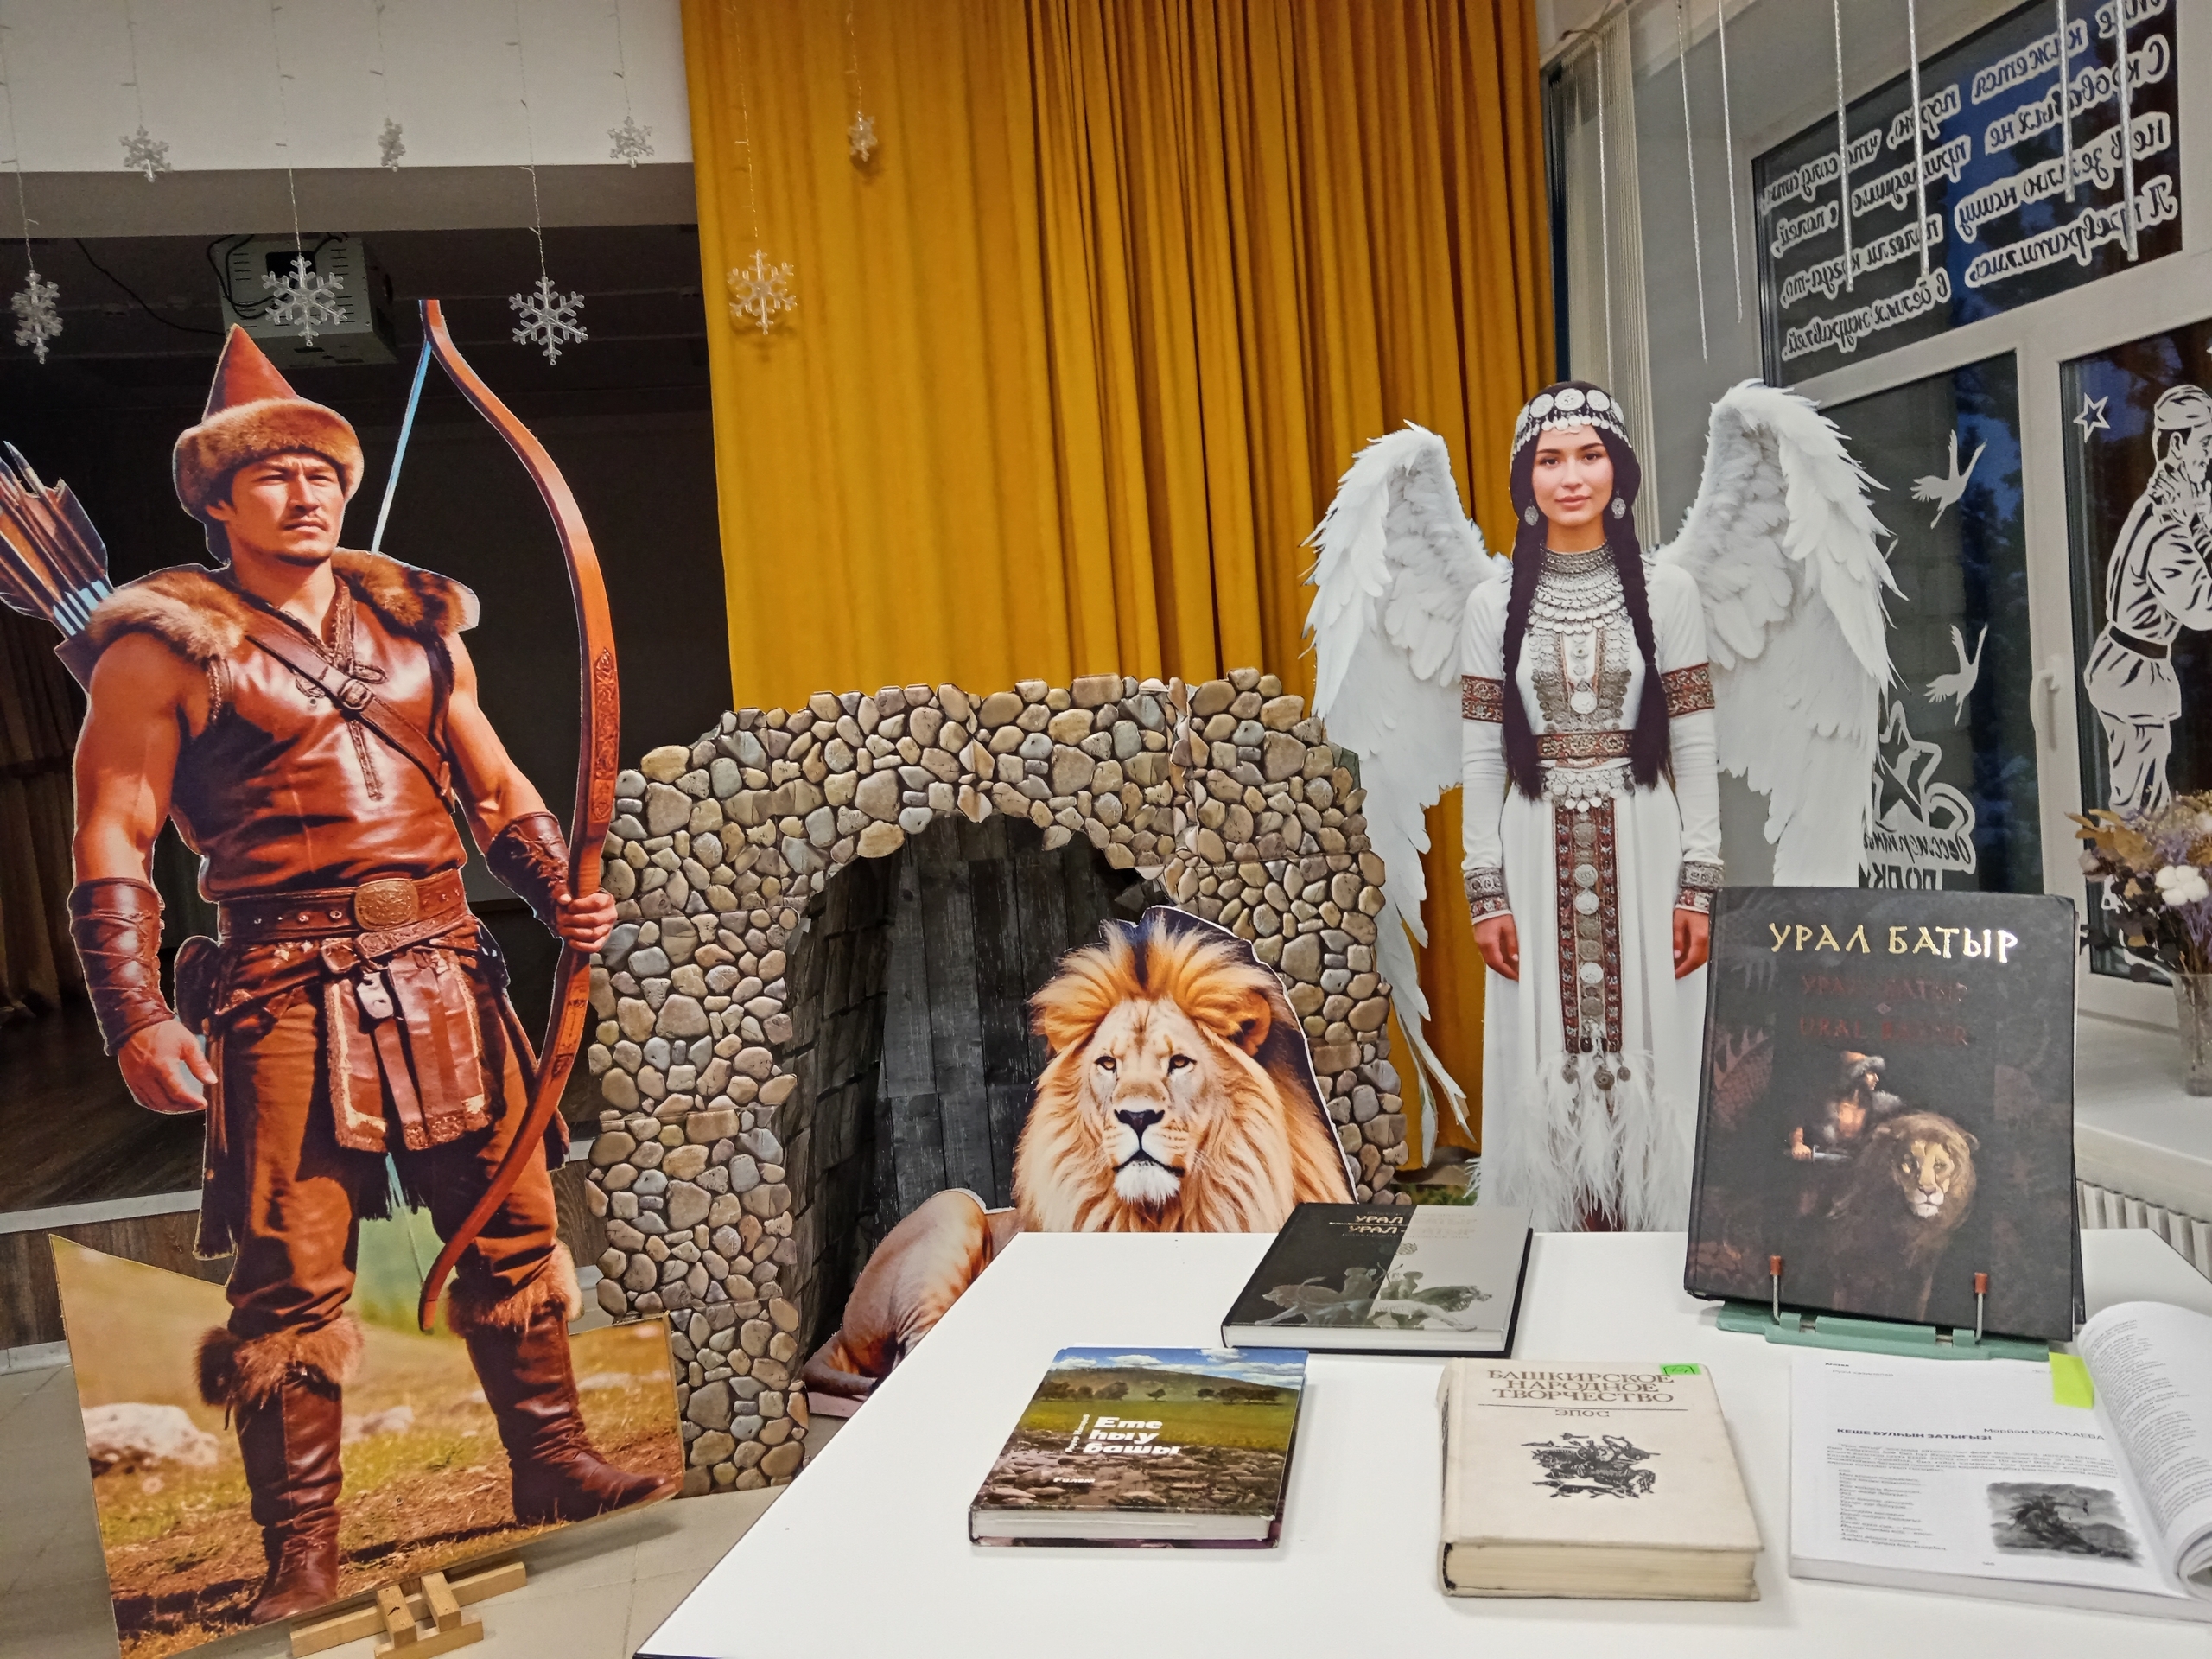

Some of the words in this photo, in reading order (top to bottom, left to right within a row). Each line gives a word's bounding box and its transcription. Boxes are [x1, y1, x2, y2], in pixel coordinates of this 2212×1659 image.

[1769, 922, 1871, 954] УРАЛ
[1888, 925, 2018, 963] БАТЫР
[1355, 1215, 1404, 1224] УРАЛ
[1487, 1370, 1675, 1383] БАШКИРСКОЕ
[1506, 1380, 1659, 1393] НАРОДНОЕ
[1492, 1389, 1675, 1402] ТВОРЧЕСТВО
[1554, 1409, 1610, 1418] ЭПОС
[1083, 1442, 1181, 1455] башы
